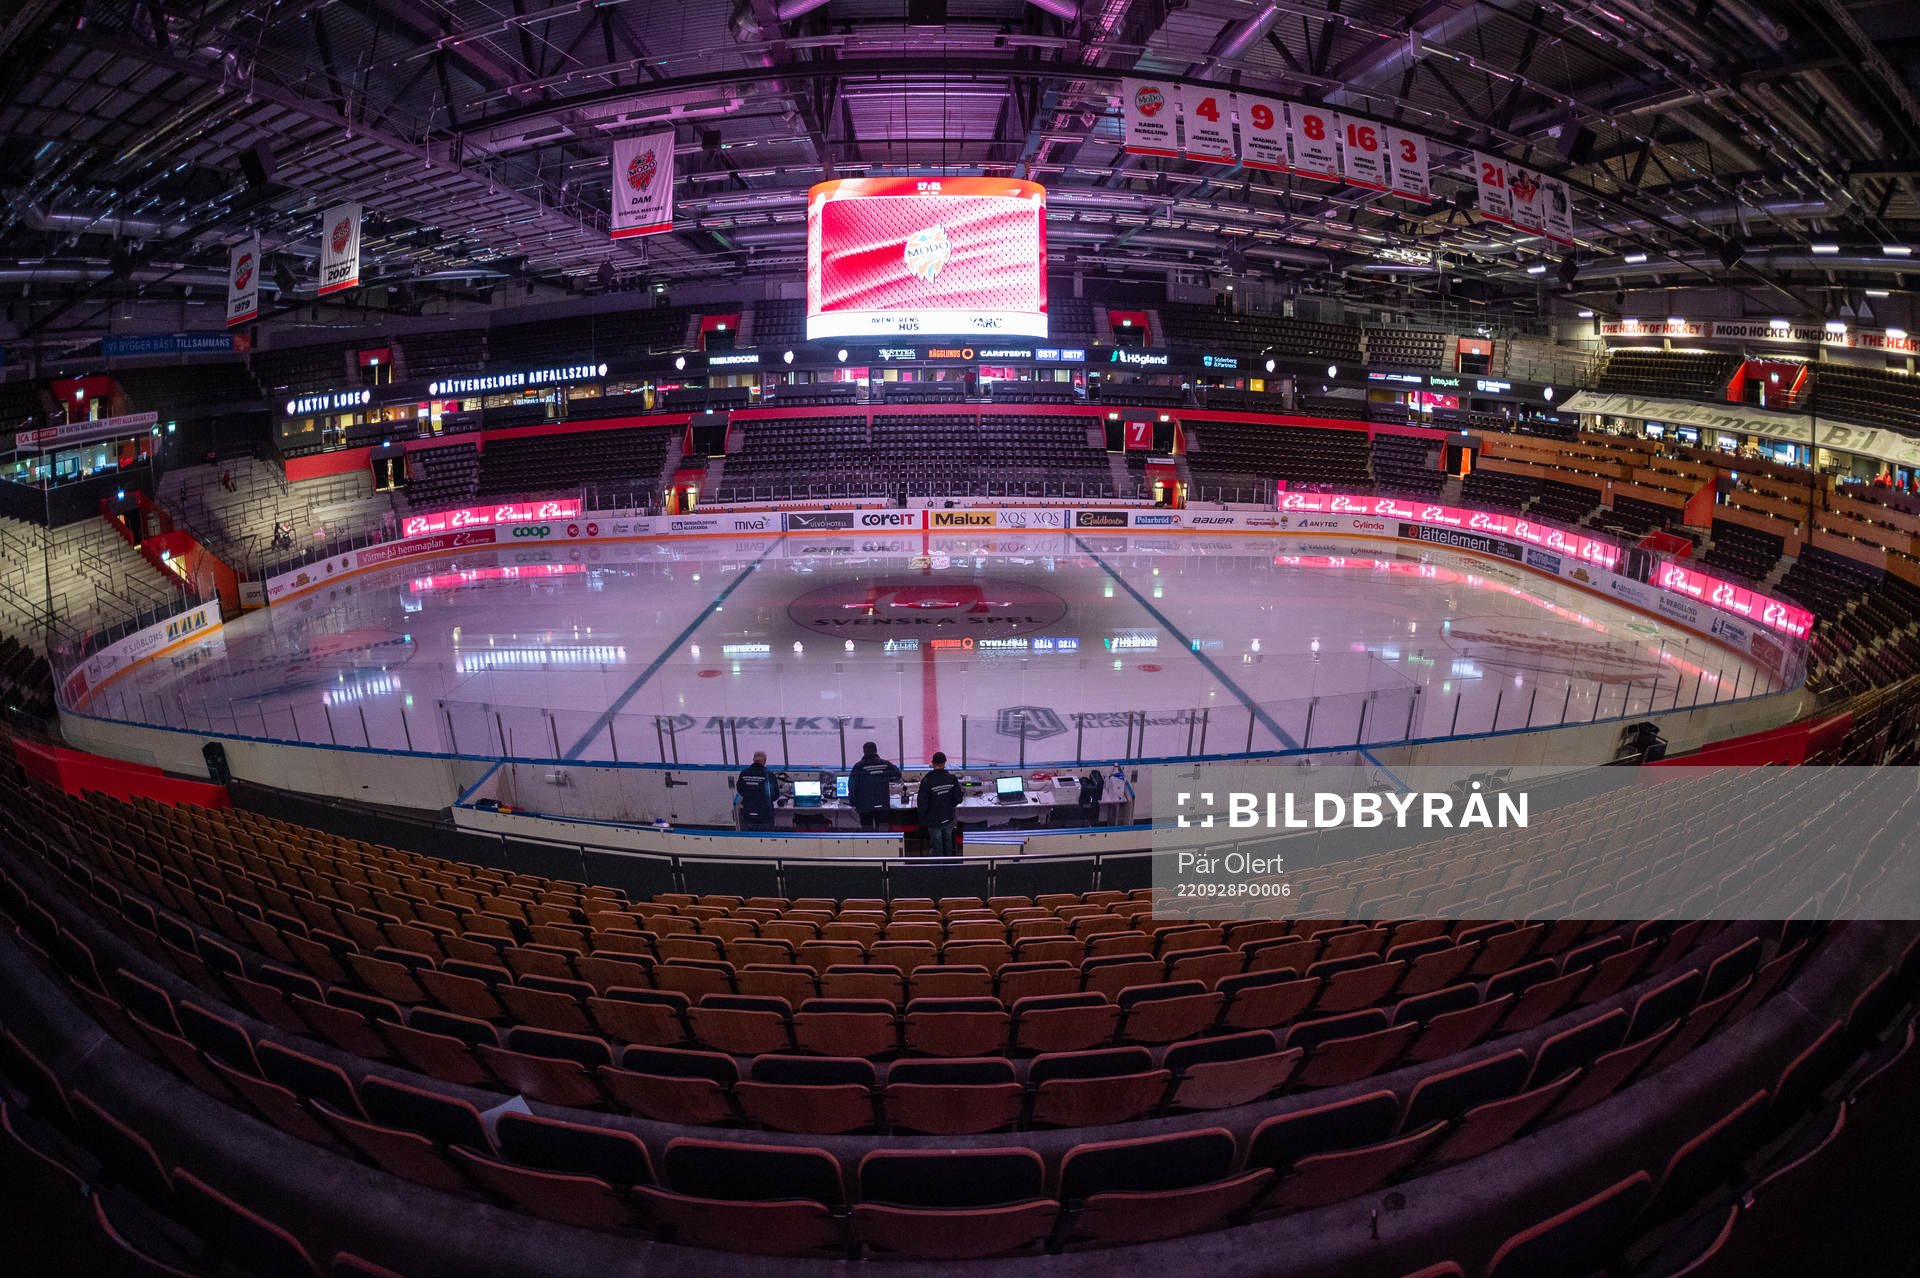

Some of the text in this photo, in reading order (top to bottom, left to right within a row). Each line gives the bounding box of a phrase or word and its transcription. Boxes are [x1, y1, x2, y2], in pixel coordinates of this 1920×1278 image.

[1196, 97, 1220, 122] 4
[1251, 104, 1274, 130] 9
[1303, 115, 1325, 140] 8
[1347, 124, 1378, 152] 16
[1400, 139, 1417, 163] 3
[1482, 162, 1504, 188] 21
[632, 196, 652, 205] DAM
[908, 241, 950, 258] MODO
[328, 266, 351, 280] 2007
[234, 301, 250, 312] 1979
[1602, 324, 1701, 334] THE HEART OF HOCKEY
[1716, 325, 1843, 343] MODO HOCKEY UNGDOM
[176, 338, 230, 348] TILLSAMMANS
[1862, 334, 1920, 351] THE HEAR
[980, 350, 1031, 358] CARSTEDTS
[1126, 354, 1168, 365] Högland
[440, 366, 596, 394] NÄTVERKSLOGEN ANFALLSZON
[298, 395, 329, 413] AKTIV
[1612, 398, 1878, 450] Nordemans Bil
[18, 434, 30, 444] ICA
[1132, 423, 1145, 441] 7
[735, 520, 764, 530] miva
[862, 513, 915, 526] coreIT
[936, 513, 991, 525] Malux
[1000, 512, 1026, 524] XQS
[1034, 512, 1060, 526] XQS
[1137, 516, 1170, 524] Polarbröd
[1353, 520, 1384, 530] Cylinda
[513, 526, 550, 538] coop
[1419, 526, 1491, 552] lättelement
[363, 539, 444, 563] Värme på hemmaplan
[813, 615, 1042, 627] SVENSKA SPEL
[1070, 711, 1145, 722] HOCKEY
